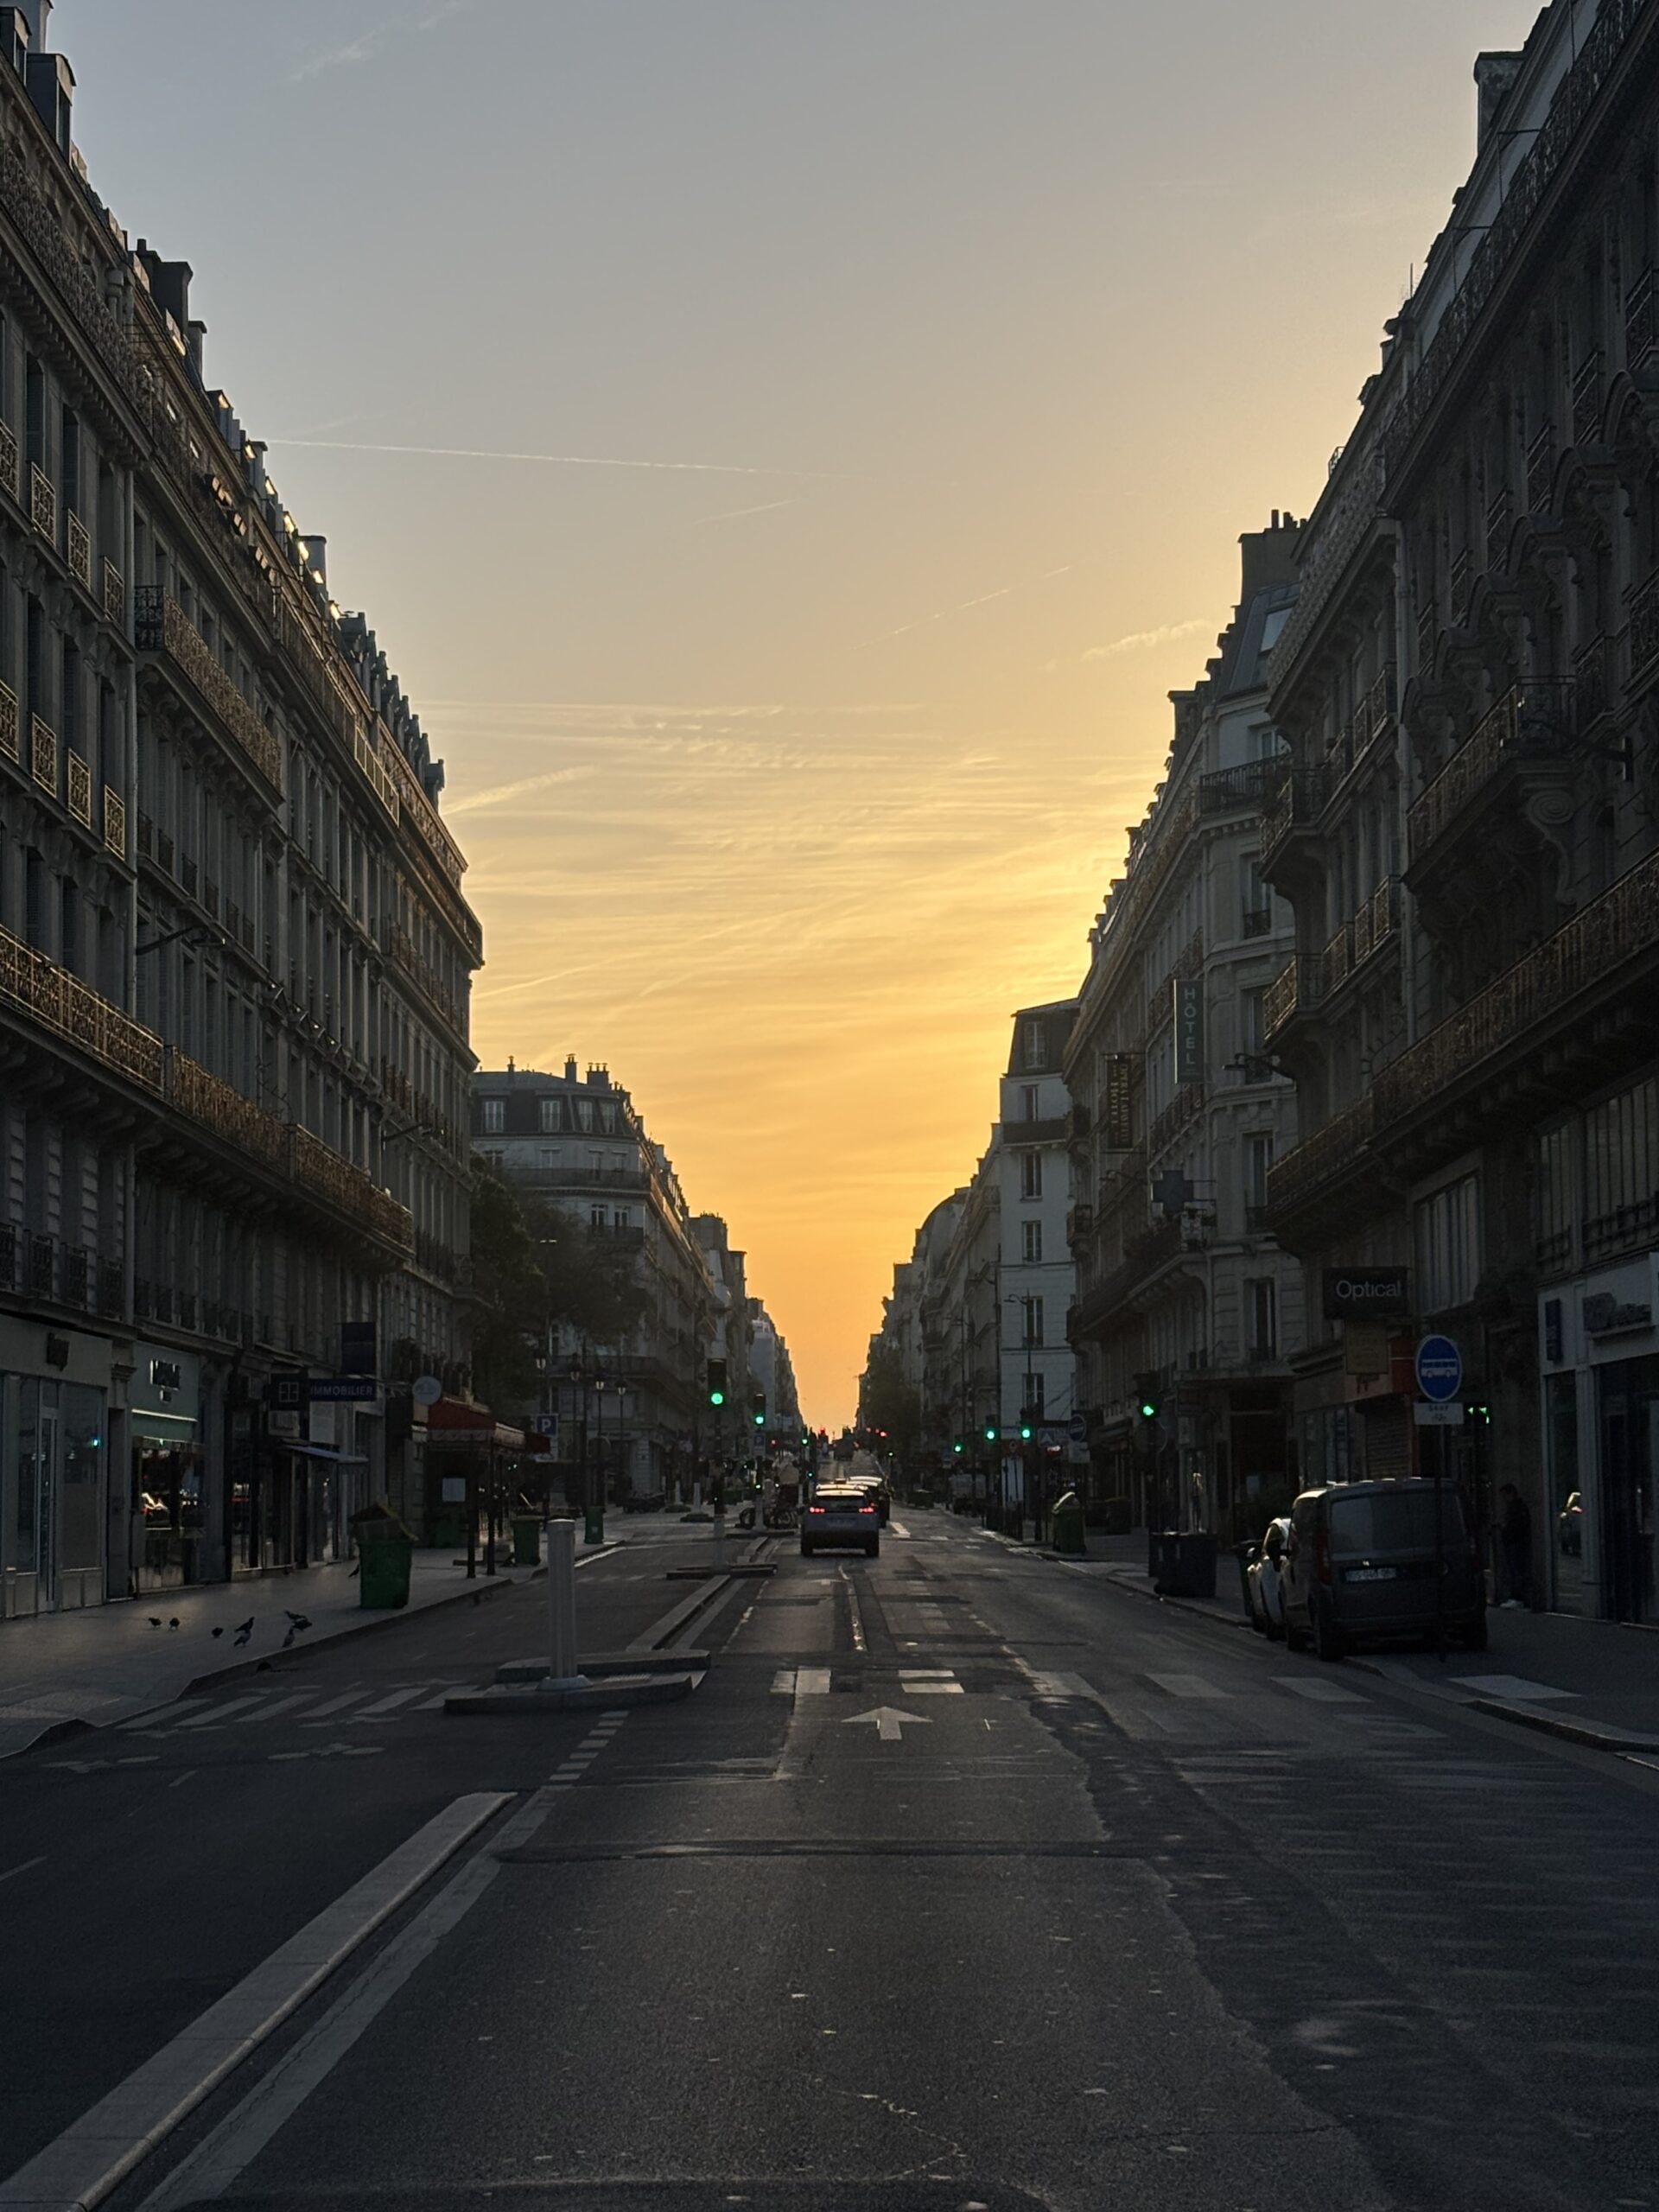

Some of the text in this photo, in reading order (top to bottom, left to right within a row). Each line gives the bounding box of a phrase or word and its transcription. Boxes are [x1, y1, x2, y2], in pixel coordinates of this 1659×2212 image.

[1335, 1280, 1402, 1300] Optical
[311, 1385, 373, 1396] IMMOBILIER
[542, 1418, 552, 1433] P
